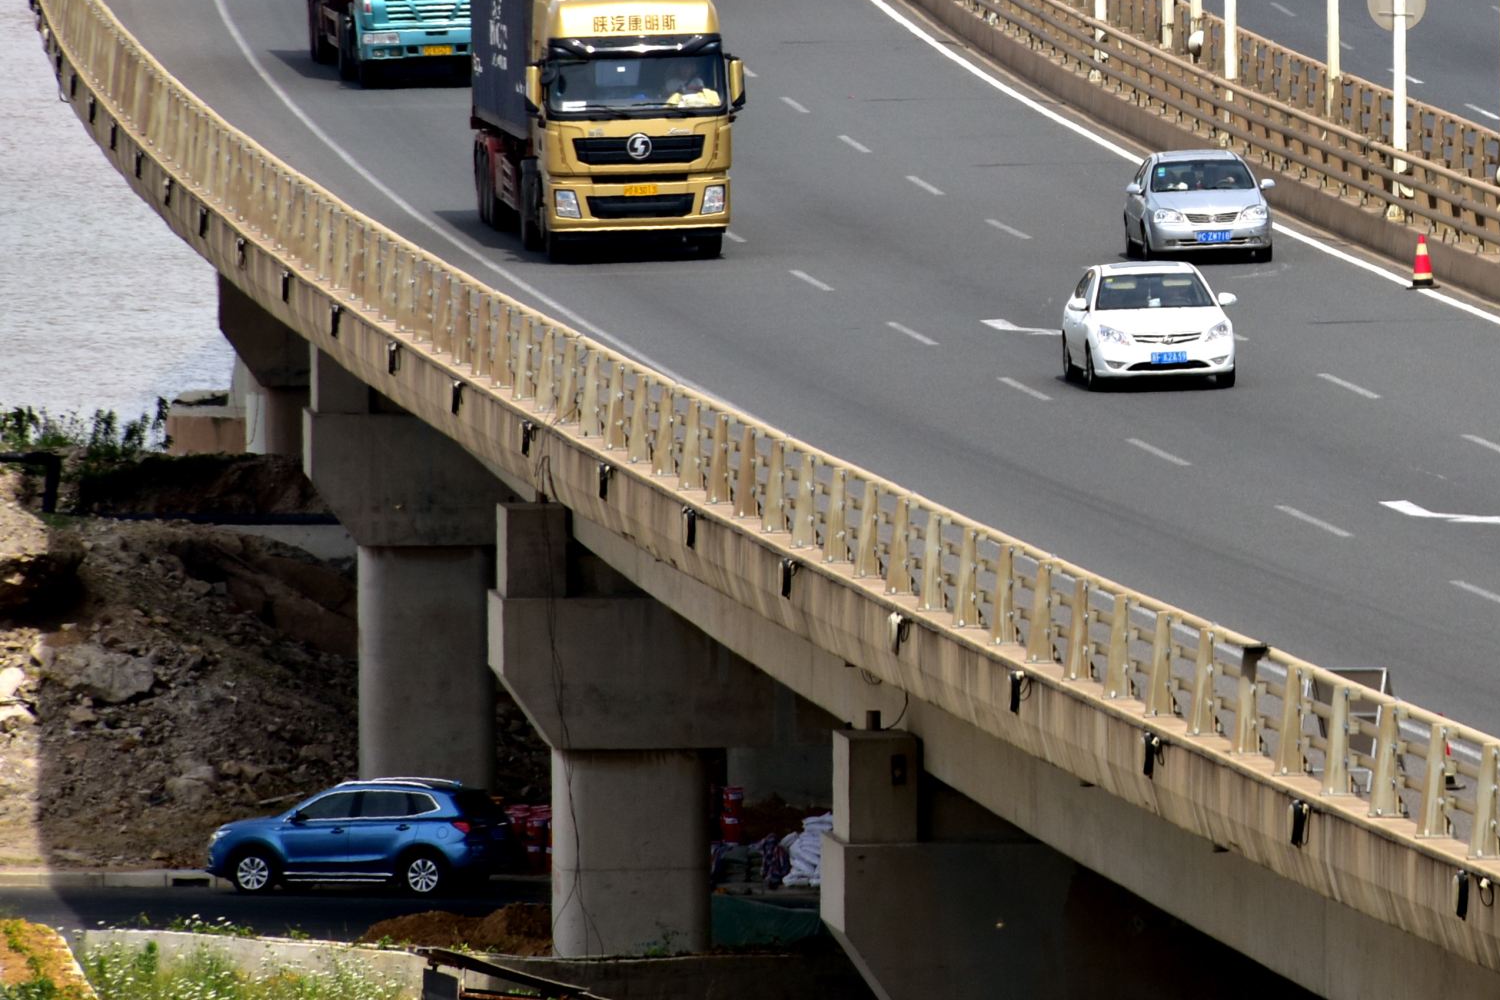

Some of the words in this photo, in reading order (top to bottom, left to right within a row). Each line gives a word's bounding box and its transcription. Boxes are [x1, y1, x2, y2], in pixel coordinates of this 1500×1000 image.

[593, 14, 676, 33] 陕汽康明斯
